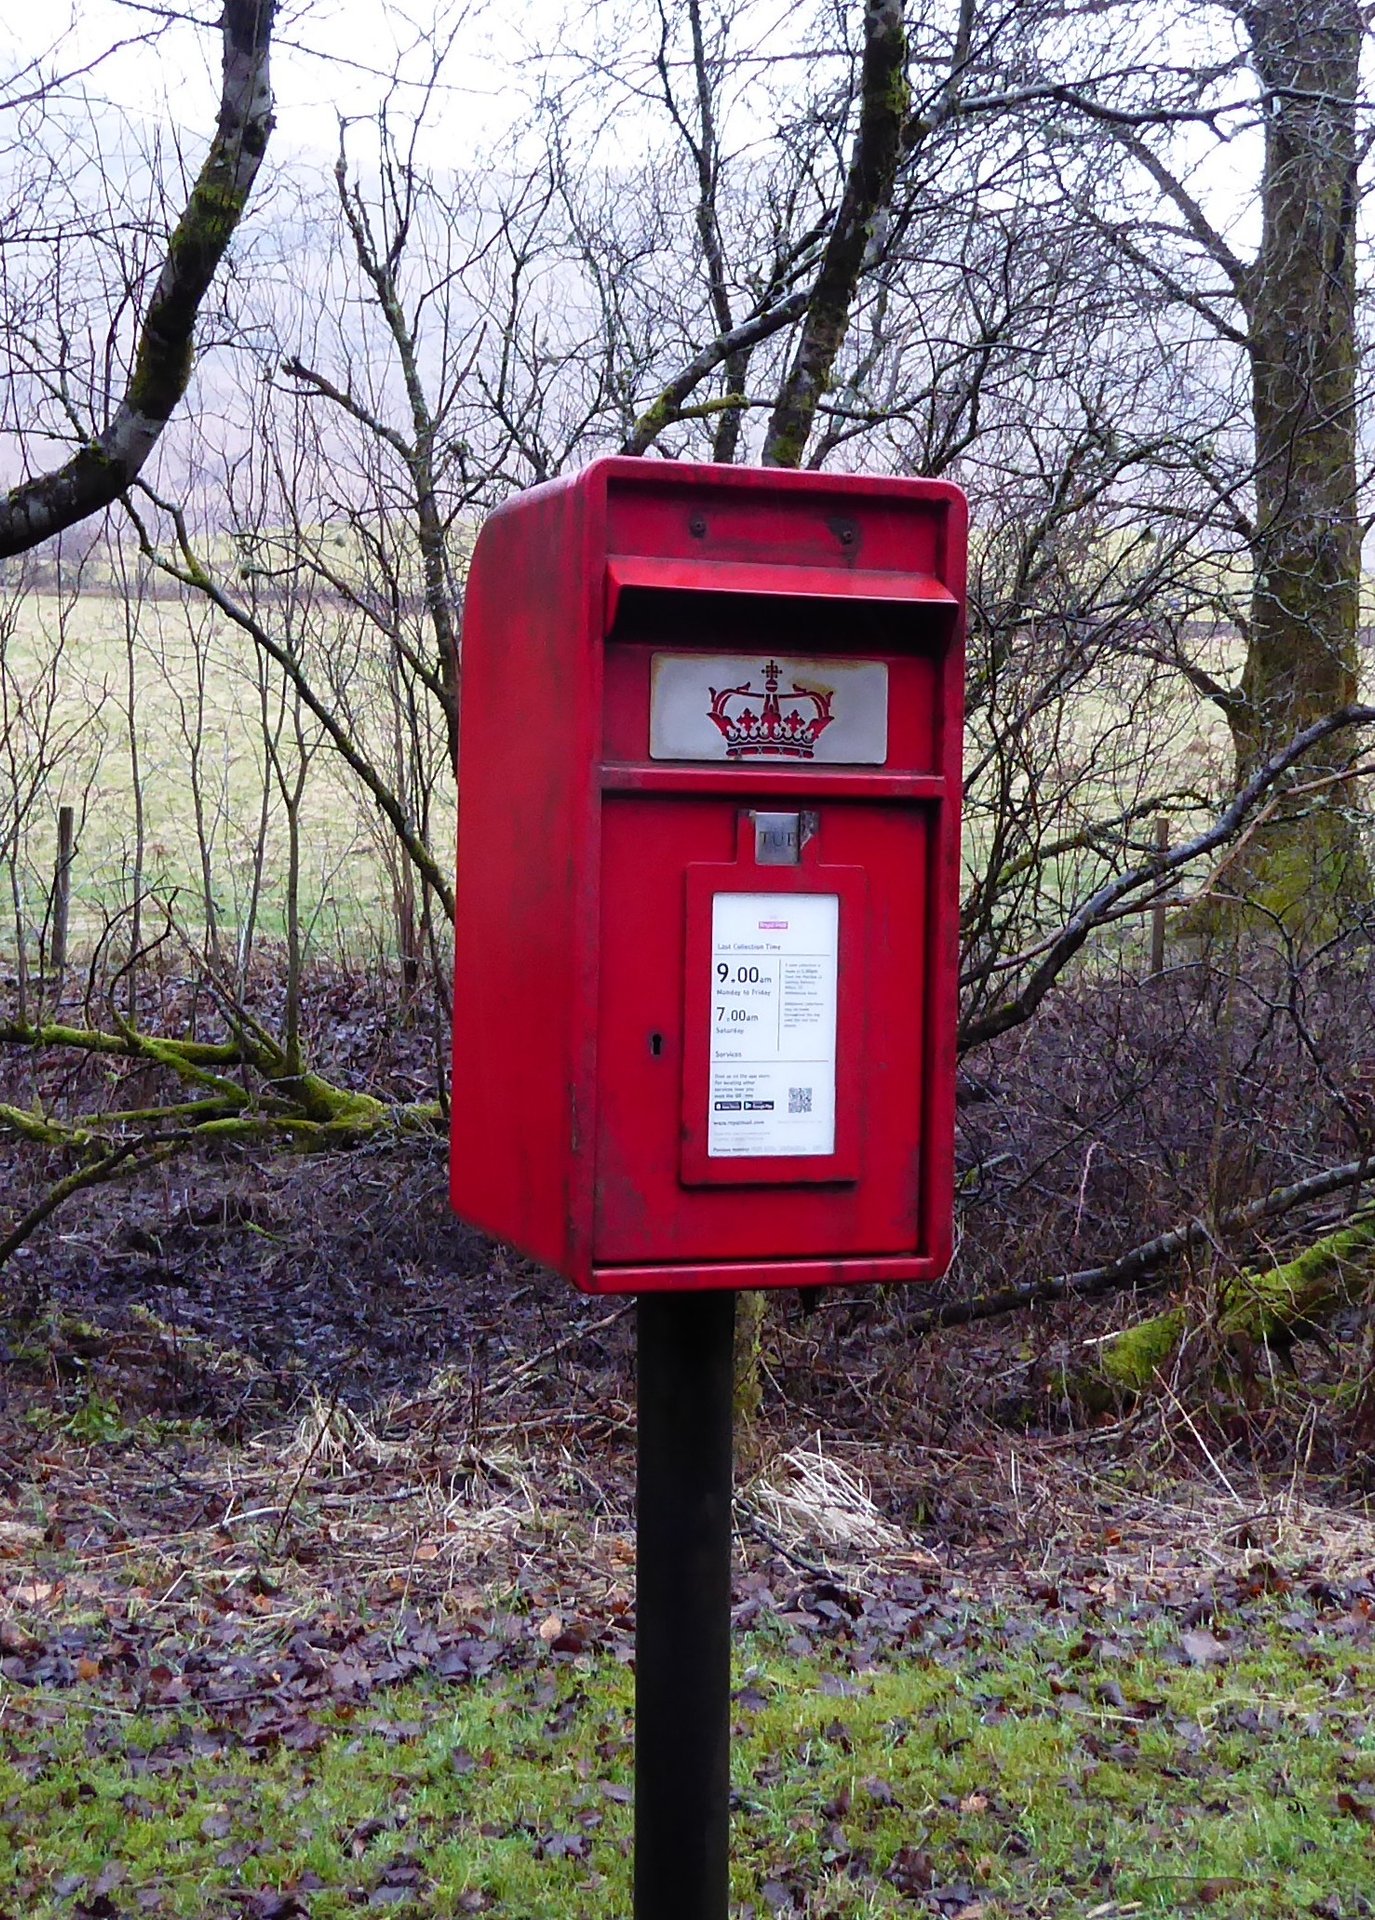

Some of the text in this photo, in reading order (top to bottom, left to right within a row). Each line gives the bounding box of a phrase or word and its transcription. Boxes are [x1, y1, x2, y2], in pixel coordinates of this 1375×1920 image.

[733, 943, 764, 951] Collection
[716, 962, 772, 984] 9.00am
[751, 989, 771, 997] Friday
[716, 1006, 759, 1022] 7.00am
[715, 1026, 744, 1035] Saturday
[715, 1050, 742, 1058] Services
